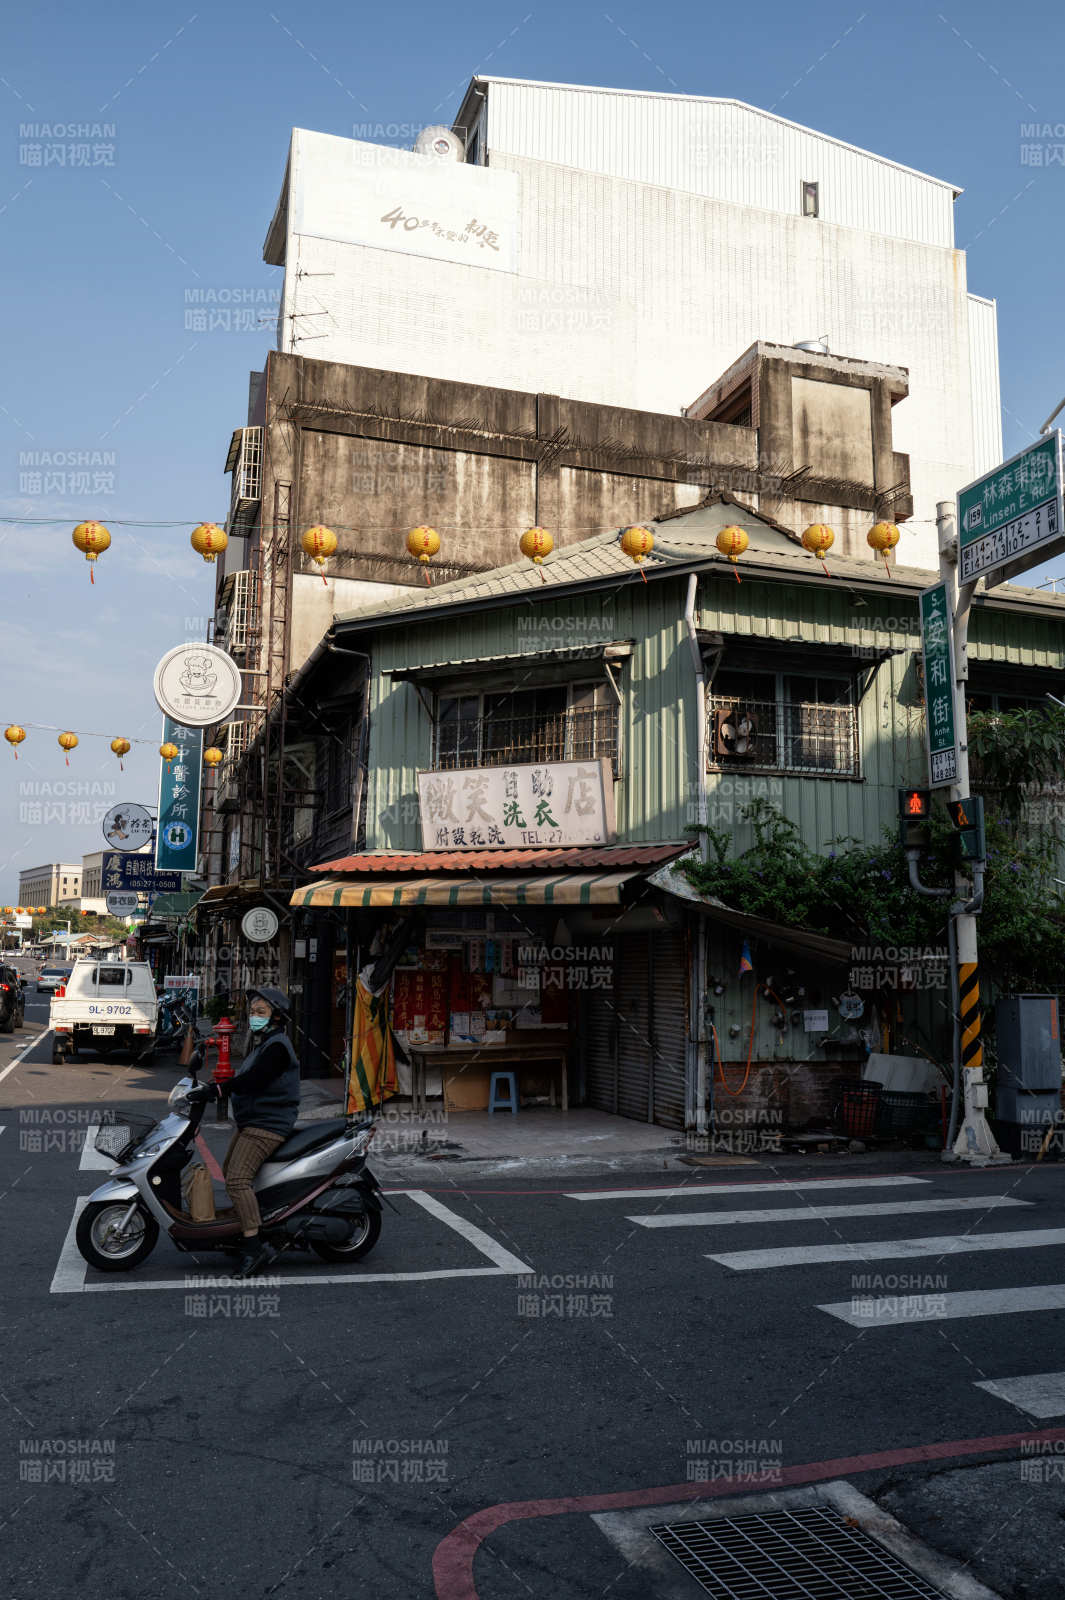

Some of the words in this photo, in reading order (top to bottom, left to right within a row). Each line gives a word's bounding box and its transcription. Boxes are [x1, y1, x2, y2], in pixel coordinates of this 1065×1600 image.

[983, 454, 1047, 509] 林森東路
[970, 509, 981, 525] 159
[983, 503, 1016, 529] Linsen
[928, 620, 950, 725] 安和街
[564, 767, 598, 816] 店
[503, 800, 560, 828] 洗衣
